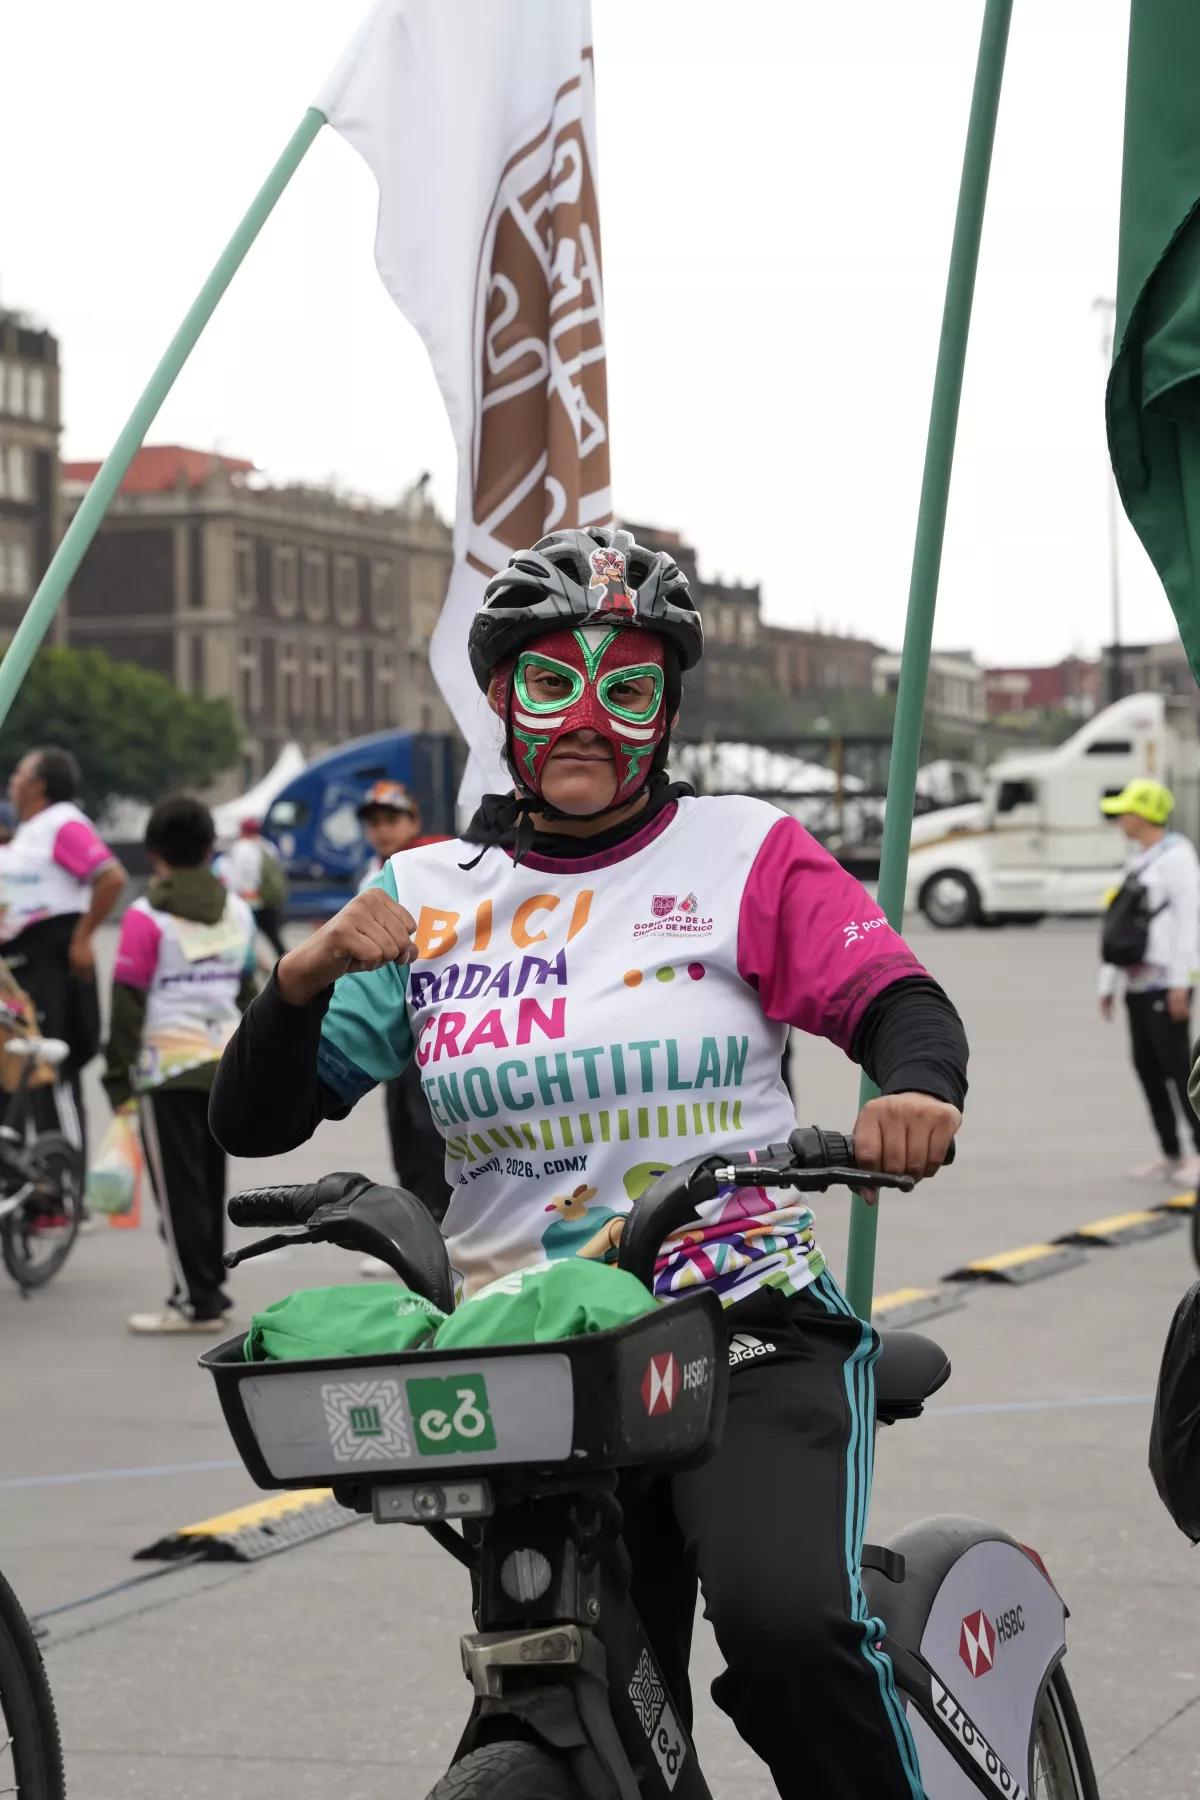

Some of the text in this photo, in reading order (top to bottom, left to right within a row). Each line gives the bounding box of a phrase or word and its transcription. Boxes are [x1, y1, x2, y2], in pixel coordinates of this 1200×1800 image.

[414, 889, 594, 961] BICI
[633, 924, 663, 937] CIUDAD
[679, 923, 713, 932] MÉXICO
[634, 915, 682, 930] GOBIERNO
[685, 916, 698, 924] DE
[410, 947, 567, 1011] RODADA
[416, 997, 566, 1067] GRAN
[421, 1035, 749, 1127] ENOCHTITLAN
[543, 1155, 588, 1176] CDMX
[683, 1356, 708, 1390] HSBC
[995, 1604, 1025, 1643] HSBC
